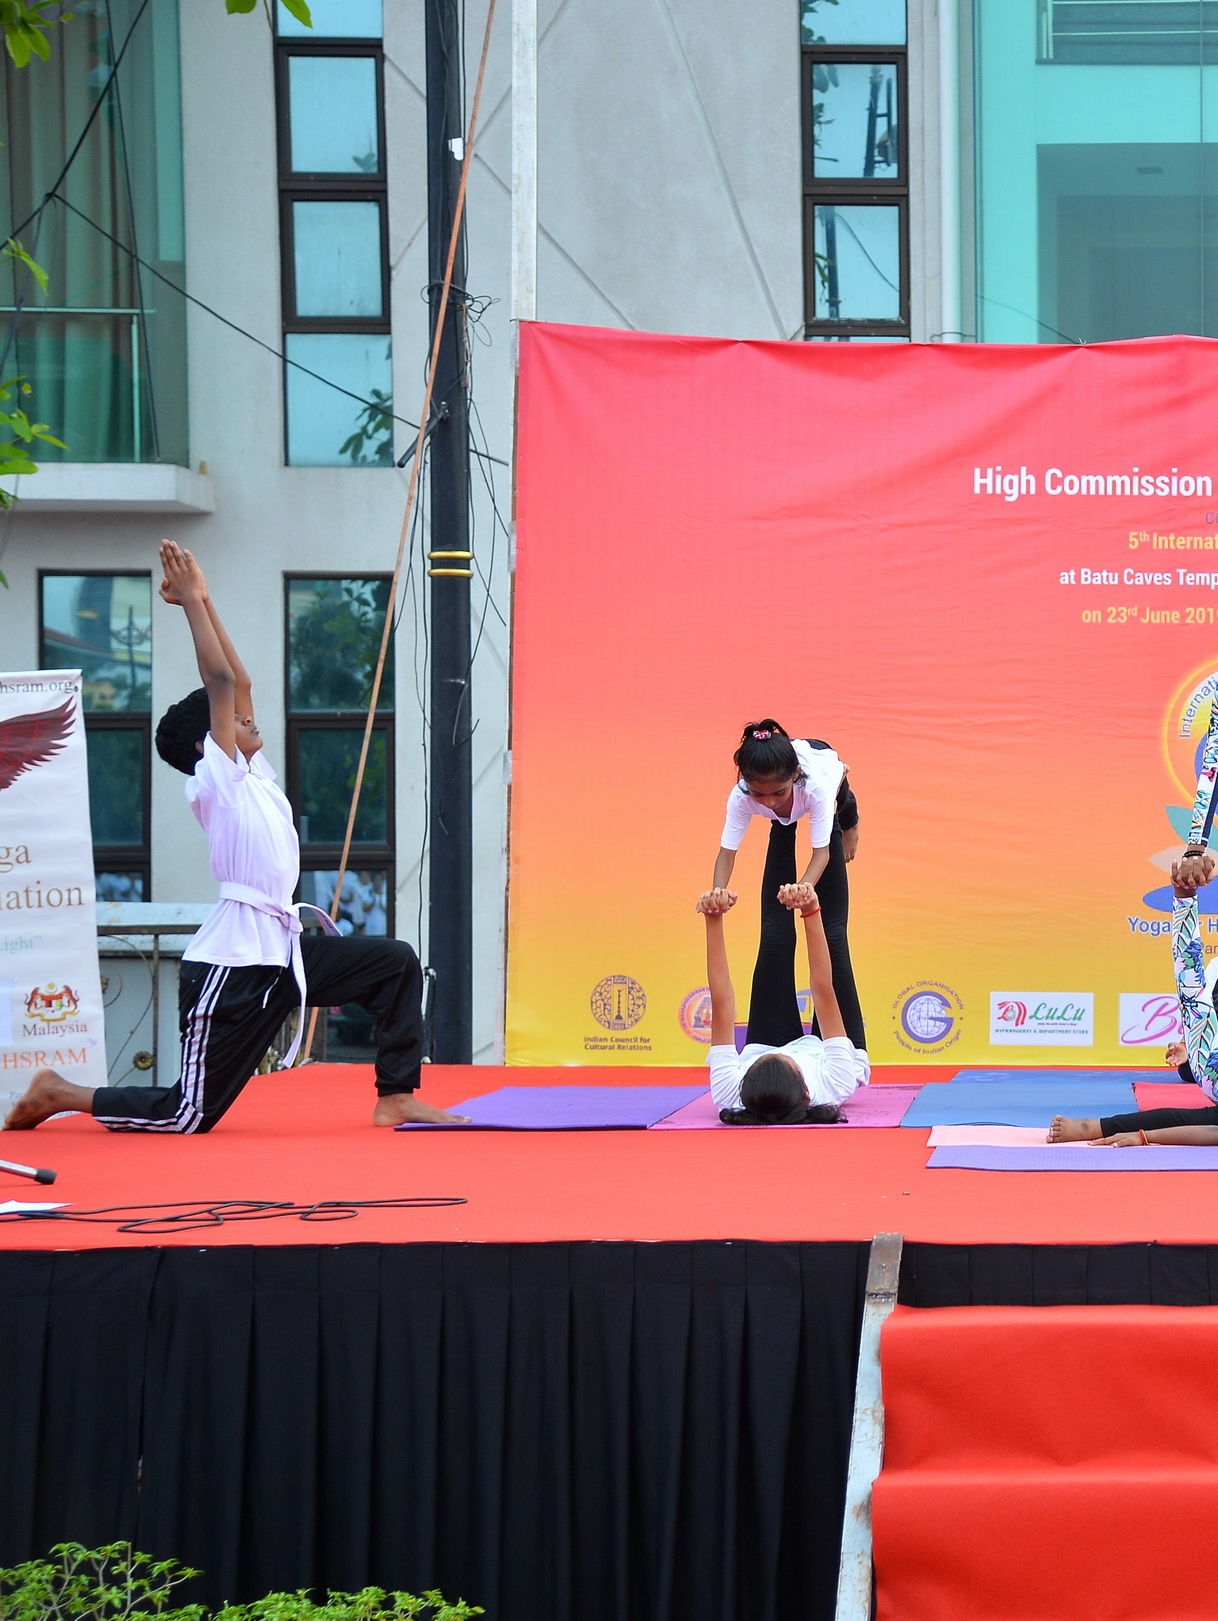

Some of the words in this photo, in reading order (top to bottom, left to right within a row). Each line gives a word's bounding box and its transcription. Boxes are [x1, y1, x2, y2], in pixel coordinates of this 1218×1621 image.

[973, 466, 1036, 502] High
[1044, 467, 1213, 497] Commission
[1128, 530, 1150, 549] 5th
[1059, 569, 1076, 585] at
[1080, 568, 1119, 585] Batu
[1123, 568, 1172, 586] Caves
[1081, 609, 1102, 623] on
[1106, 605, 1138, 623] 23rd
[1140, 607, 1181, 624] June
[1127, 917, 1172, 937] Yoga
[892, 984, 915, 1009] GLOBAL
[916, 980, 964, 1010] ORGANISATION
[1028, 1002, 1086, 1021] LuLu
[22, 1020, 88, 1038] Malaysia
[584, 1035, 608, 1043] Indian
[610, 1035, 638, 1043] Council
[639, 1035, 651, 1043] for
[584, 1043, 616, 1051] Cultural
[893, 1030, 913, 1050] People
[922, 1046, 945, 1054] Indian
[945, 1029, 962, 1047] Origin
